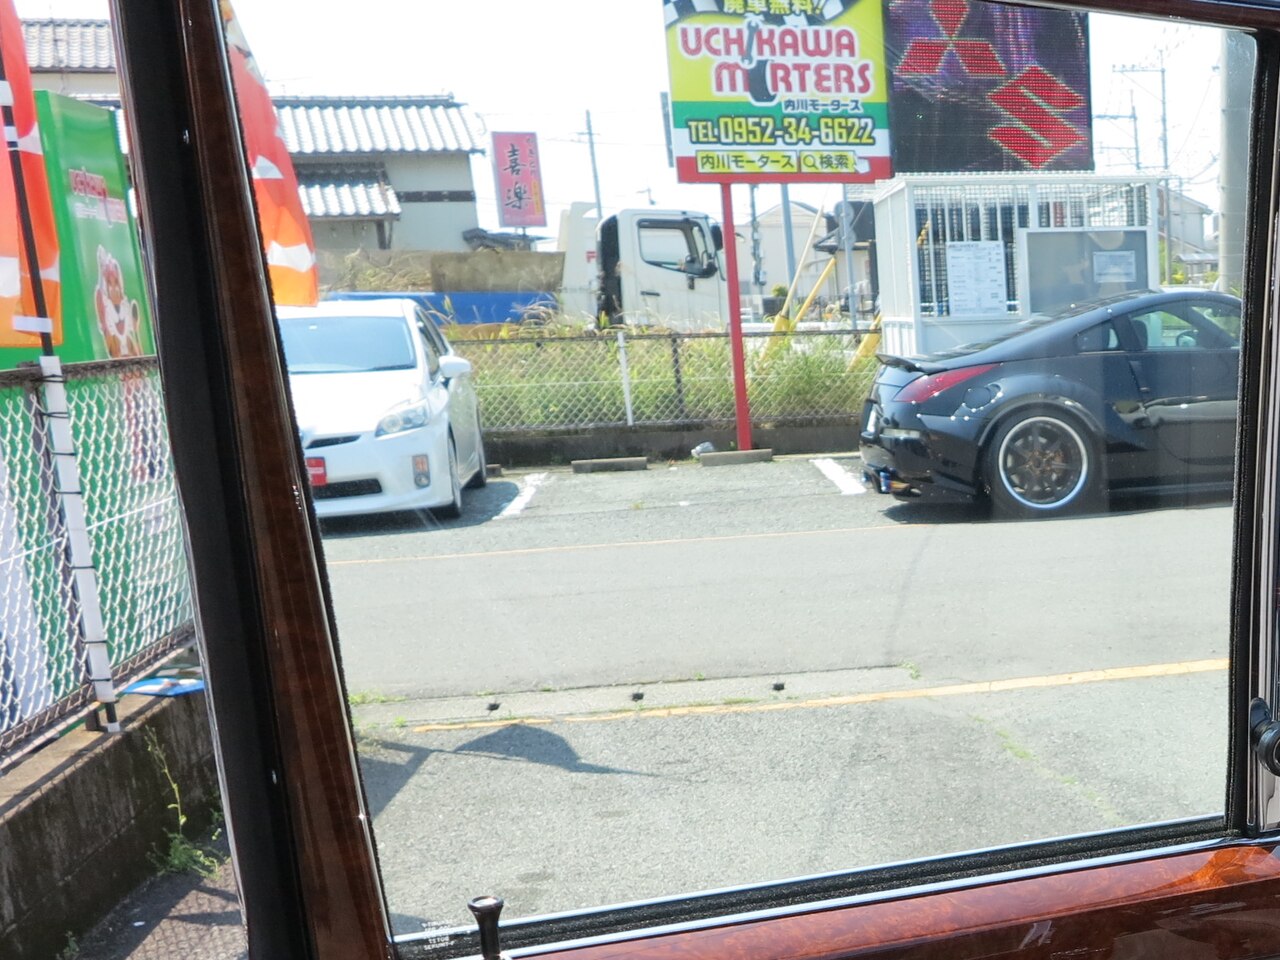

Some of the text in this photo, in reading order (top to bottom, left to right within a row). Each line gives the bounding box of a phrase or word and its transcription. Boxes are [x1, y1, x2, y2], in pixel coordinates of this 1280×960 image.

[784, 100, 861, 112] 内川モータース
[719, 117, 875, 145] 0952-34-6622
[700, 155, 849, 169] 内川モータース 検索
